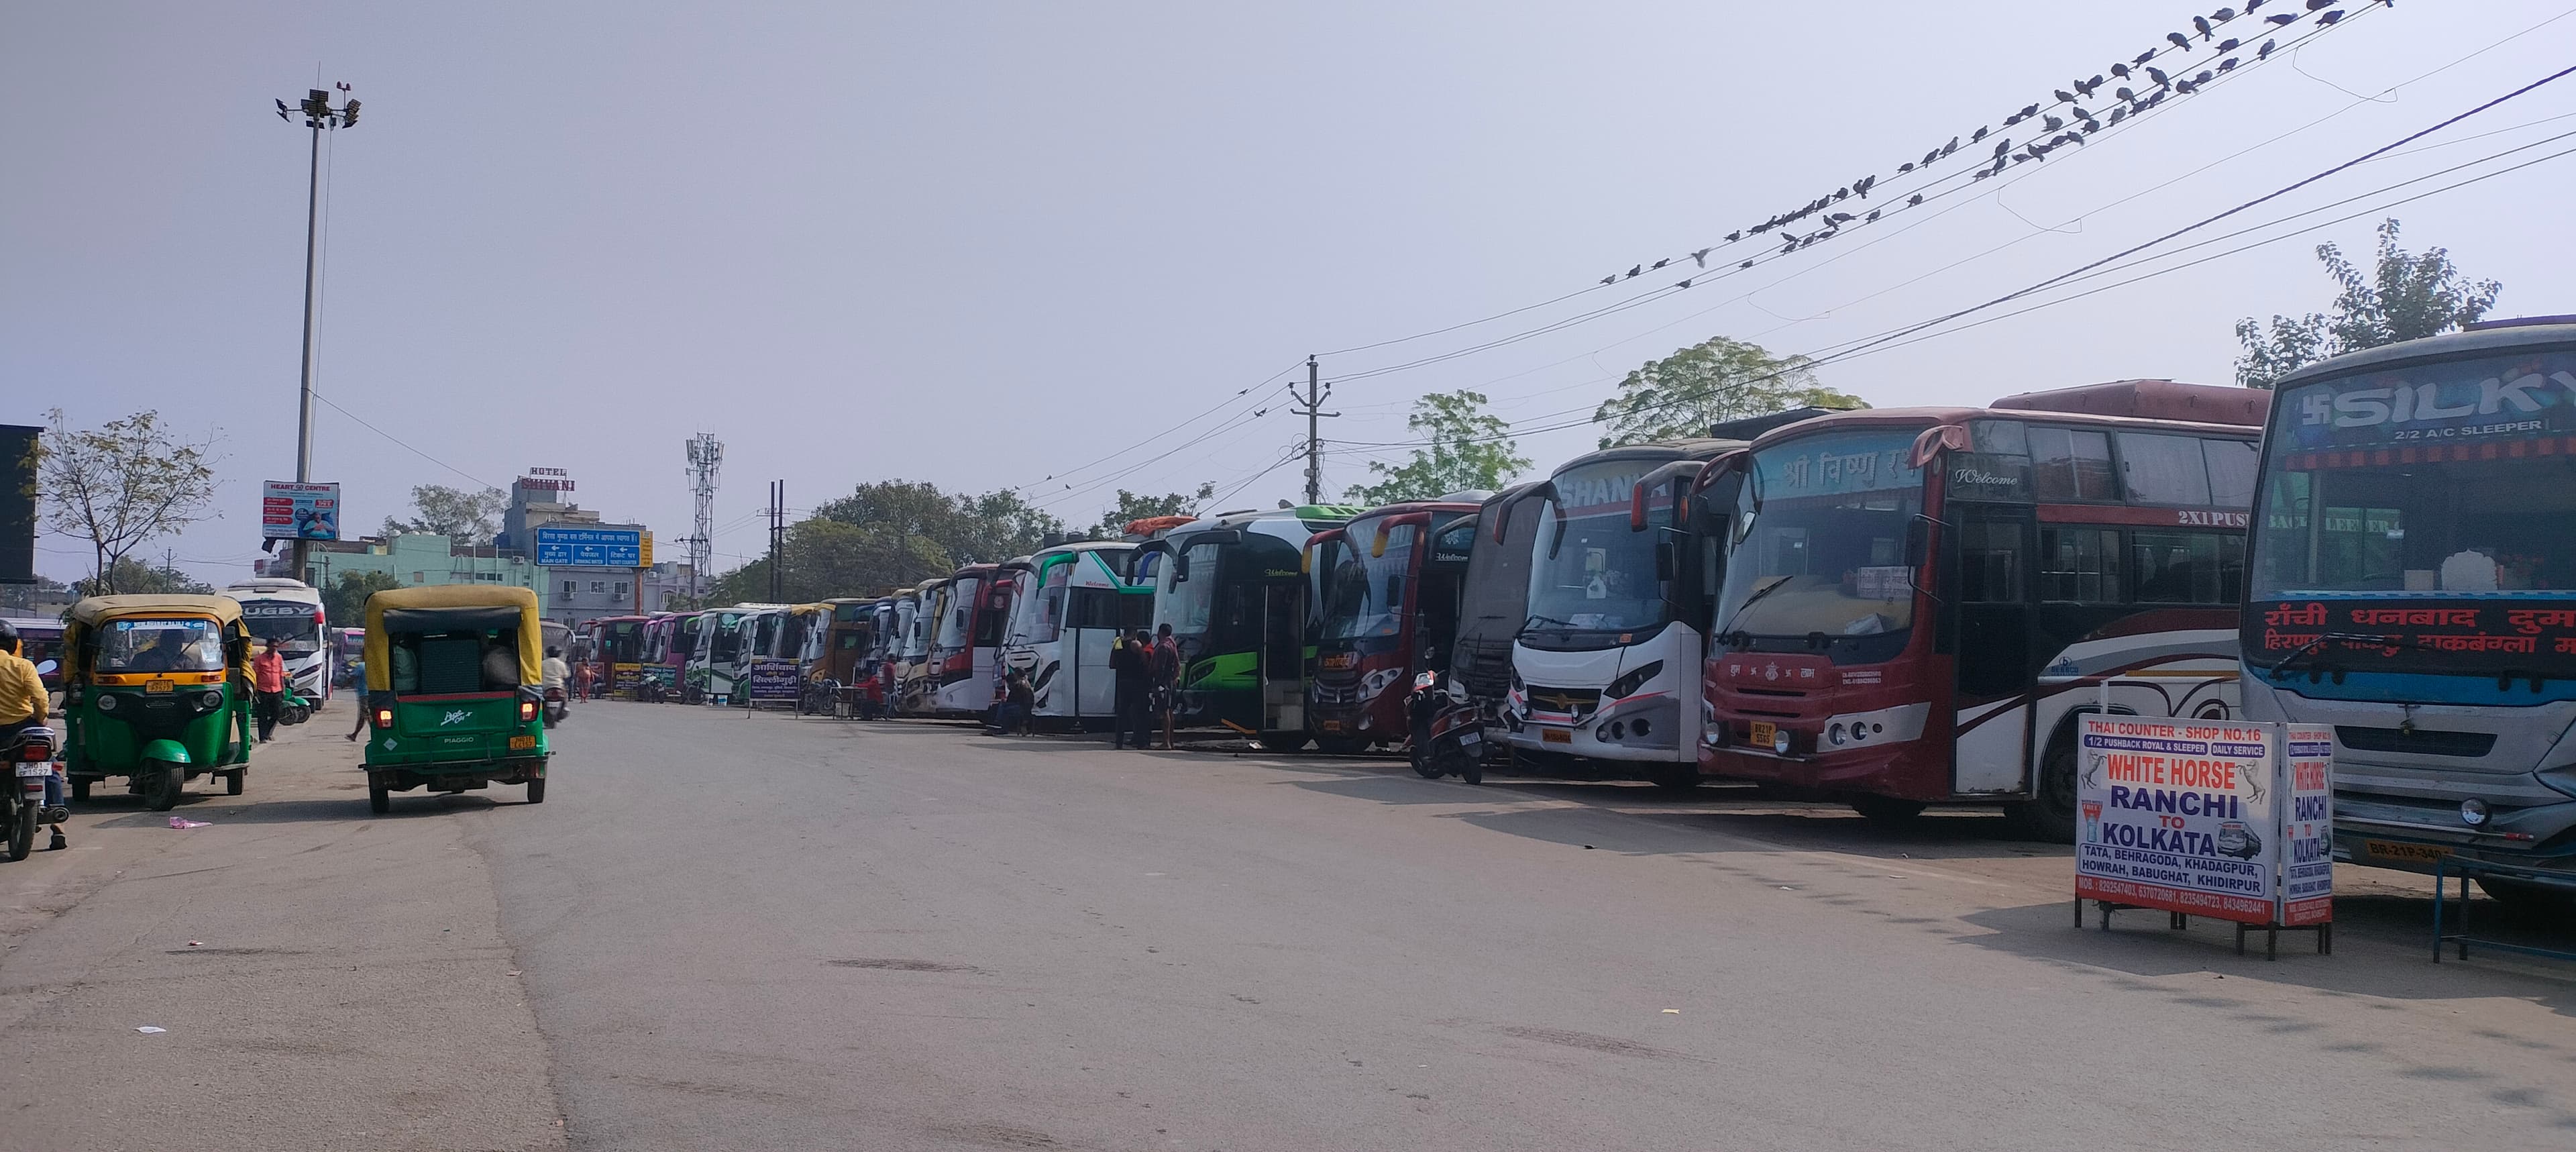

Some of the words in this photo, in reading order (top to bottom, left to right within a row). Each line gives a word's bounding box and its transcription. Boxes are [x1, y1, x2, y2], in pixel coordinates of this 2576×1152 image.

[2395, 430, 2420, 439] 2/2
[2426, 428, 2455, 437] A/C
[2461, 420, 2542, 437] SLEEPER
[531, 467, 566, 476] HOTEL
[1784, 455, 1810, 488] श्री
[1819, 452, 1879, 488] विष्णु
[1955, 468, 2018, 486] Welcome
[522, 478, 575, 491] SHIVANI
[1555, 472, 1667, 510] SHANA
[2325, 518, 2390, 532] LEEPER
[1436, 553, 1469, 562] Welcom
[242, 607, 315, 615] UGBY
[2265, 603, 2329, 626] राँची
[2350, 609, 2480, 628] धनबाद
[2088, 721, 2114, 734] THAI
[2118, 723, 2175, 737] COUNTER
[2186, 727, 2219, 741] SHOP
[2224, 728, 2261, 741] NO.16
[2088, 737, 2102, 747] 1/2
[2104, 739, 2141, 749] PUSHBACK
[2142, 741, 2165, 751] ROYAL
[2166, 743, 2171, 751] &
[2173, 743, 2206, 753] SLEEPER
[2212, 745, 2232, 755] DAILY
[2233, 745, 2263, 756] SERVICE
[2107, 753, 2165, 784] WHITE
[2171, 758, 2236, 790] HORSE
[2110, 785, 2238, 819] RANCHI
[2295, 796, 2326, 822] RANCHI
[2158, 815, 2186, 829] TO
[2304, 823, 2312, 837] TO
[2103, 822, 2216, 857] KOLKATA
[2294, 837, 2321, 863] KOLKATA
[2084, 845, 2112, 860] TATA,
[2114, 849, 2181, 870] BEHRAGODA,
[2185, 858, 2258, 878] KHADAGPUR,
[2082, 859, 2129, 877] HOWRAH,
[2132, 866, 2191, 885] BABUGHAT,
[2197, 874, 2260, 892] KHIDIRPUR
